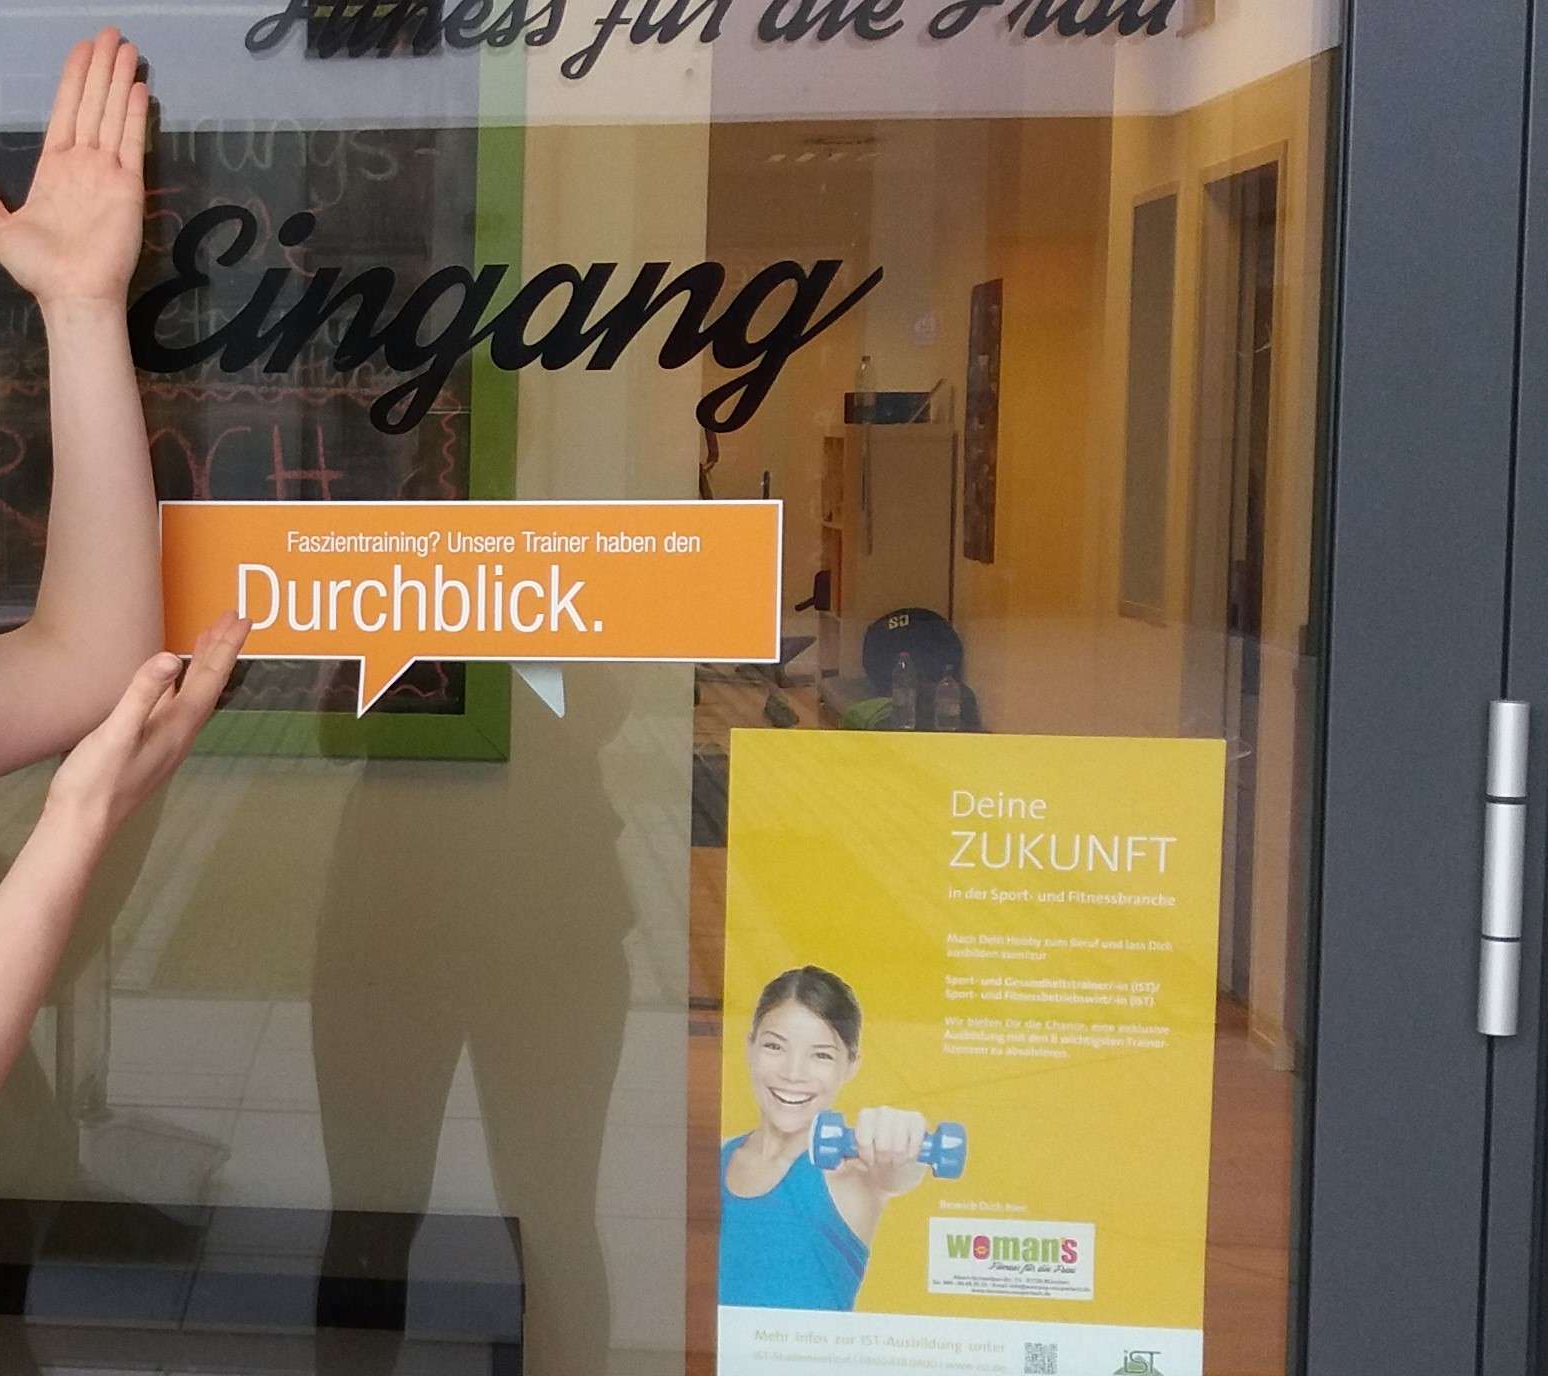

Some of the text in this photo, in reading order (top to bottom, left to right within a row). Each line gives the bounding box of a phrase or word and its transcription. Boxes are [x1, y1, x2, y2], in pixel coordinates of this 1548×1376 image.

[125, 203, 884, 436] Eingang
[286, 530, 701, 556] Faszientraining? Unsere Trainer haben den
[238, 563, 604, 633] Durchblick.
[952, 789, 1047, 820] Deine
[949, 831, 1177, 873] ZUKUNFT
[964, 888, 987, 901] der
[991, 888, 1033, 905] Sport-
[1038, 891, 1065, 903] und
[1068, 891, 1177, 907] Fitnessbranche
